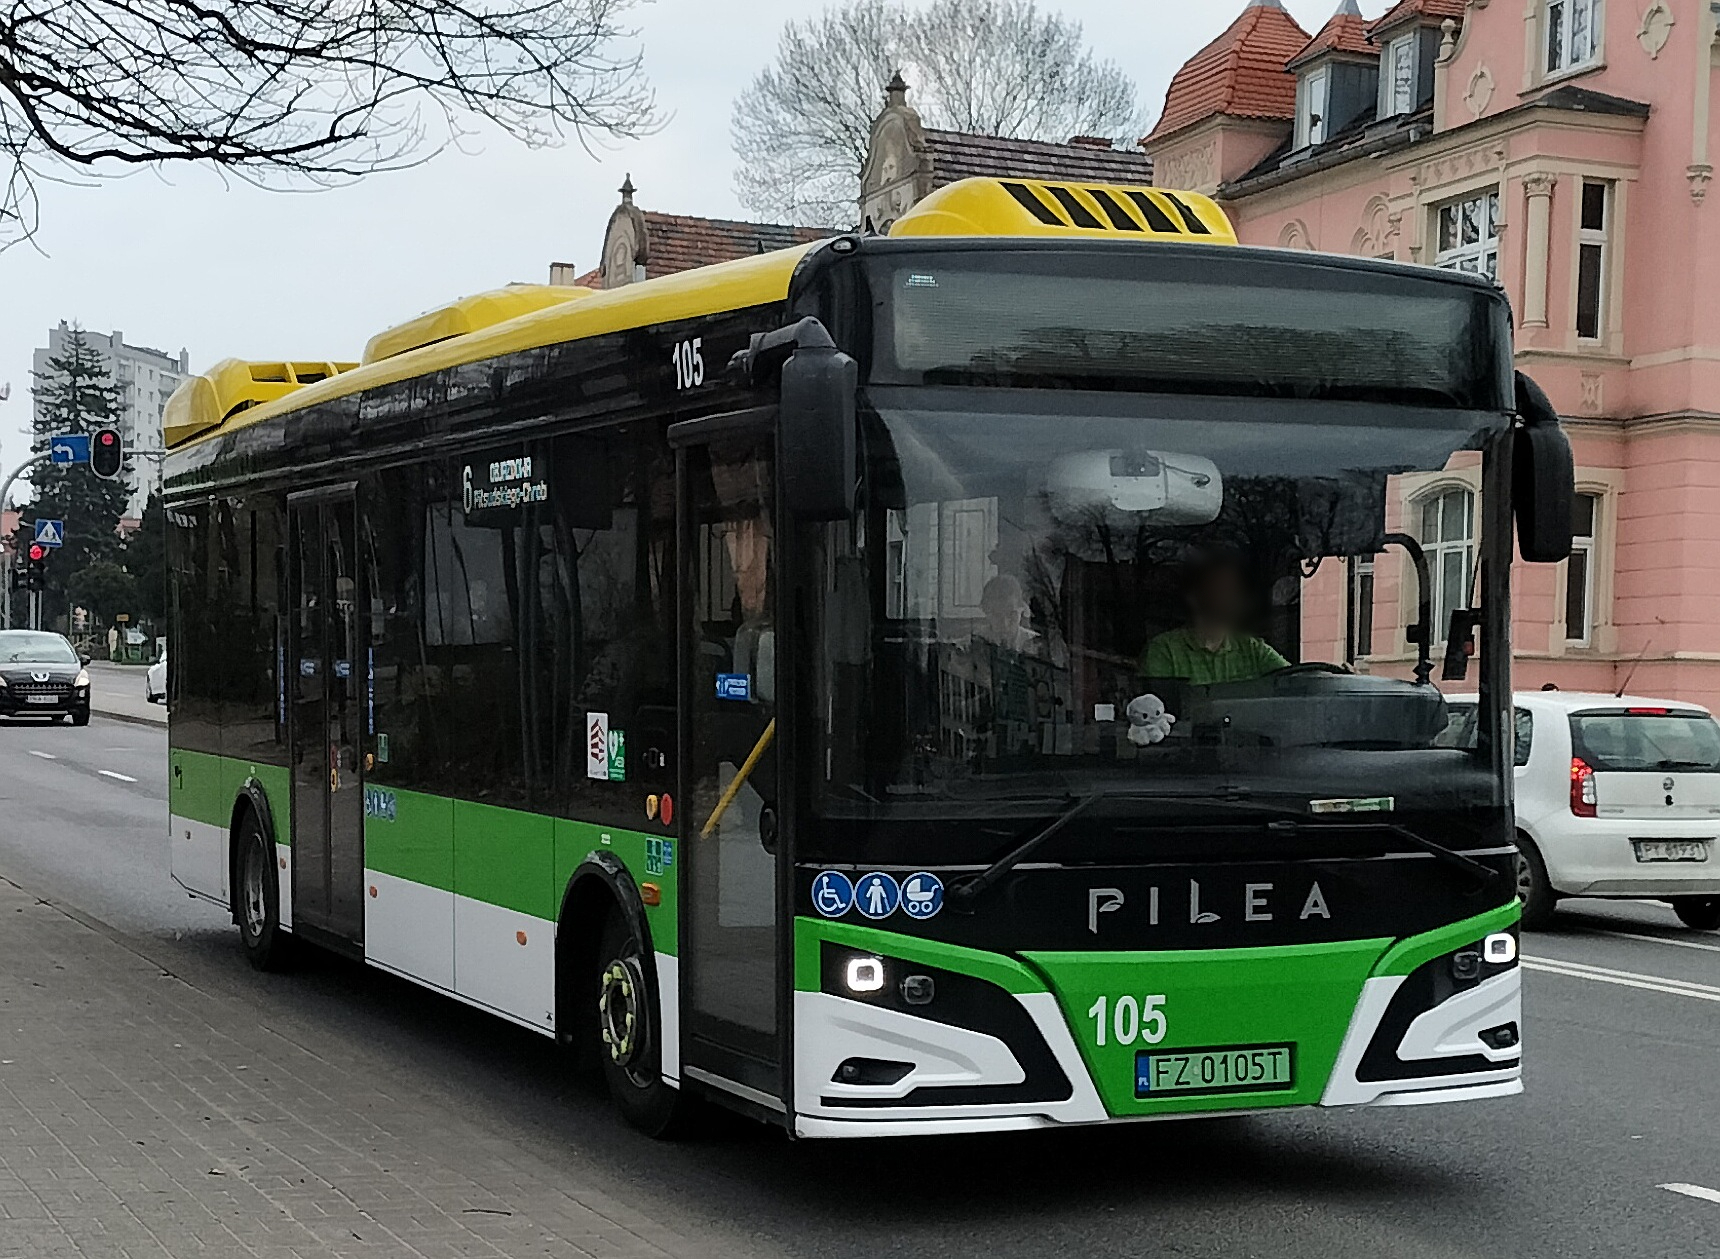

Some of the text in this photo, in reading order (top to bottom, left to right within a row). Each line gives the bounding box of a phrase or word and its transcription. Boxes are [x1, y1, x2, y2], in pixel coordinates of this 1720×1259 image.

[673, 337, 704, 390] 105
[463, 465, 473, 514] 6
[1088, 878, 1331, 934] PILEA
[1088, 994, 1167, 1046] 105
[1155, 1056, 1191, 1088] FZ
[1200, 1051, 1283, 1084] 0105T
